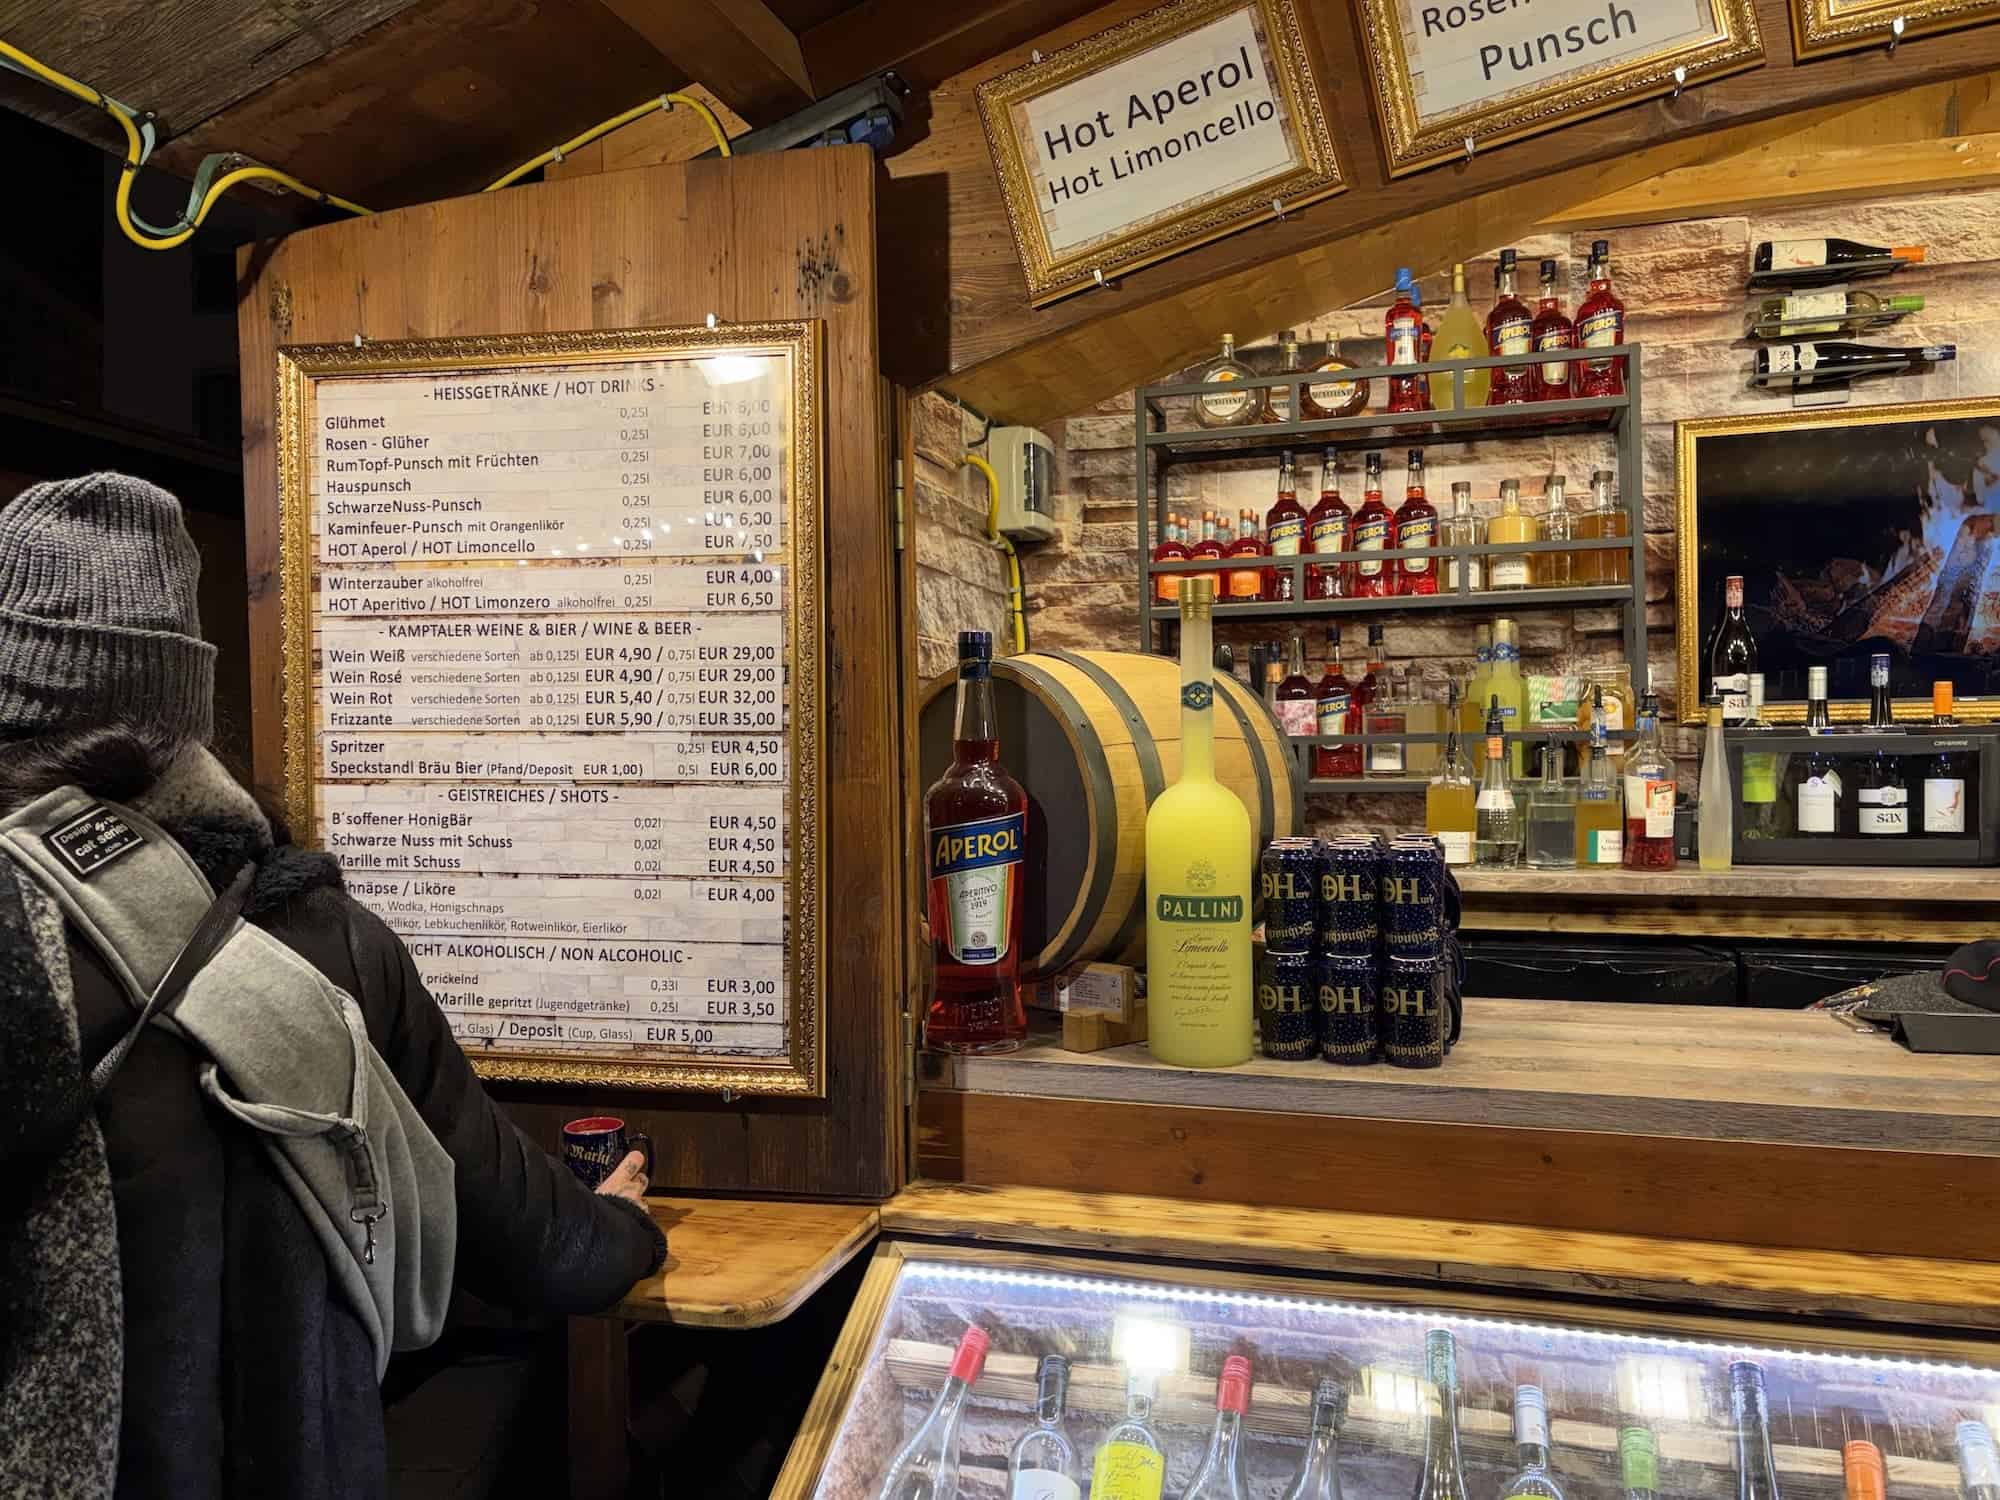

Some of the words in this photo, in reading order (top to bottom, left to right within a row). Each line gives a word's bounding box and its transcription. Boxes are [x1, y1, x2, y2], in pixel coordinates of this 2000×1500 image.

[1480, 2, 1636, 80] Punsch
[1045, 111, 1114, 161] Hot
[1128, 46, 1253, 129] Aperol
[1049, 167, 1103, 204] Hot
[1110, 100, 1274, 180] Limoncello
[434, 382, 548, 401] HEISSGETRÄNKE
[565, 381, 596, 396] HOT
[325, 416, 385, 429] Glühmet
[326, 438, 367, 450] Rosen
[382, 436, 429, 449] Glüher
[704, 424, 732, 437] EUR
[327, 456, 443, 474] RumTopf-Punsch
[448, 455, 470, 469] mit
[476, 454, 539, 467] Früchten
[621, 452, 649, 463] 0,25l
[704, 446, 733, 459] EUR
[739, 444, 770, 460] 7,00
[327, 478, 411, 494] Hauspunsch
[621, 474, 649, 485] 0,25l
[704, 468, 733, 481] EUR
[739, 467, 771, 482] 6,00
[327, 498, 482, 514] SchwarzeNuss-Punsch
[622, 495, 650, 506] 0,25l
[704, 490, 734, 504] EUR
[739, 489, 772, 505] 6,00
[328, 520, 462, 536] Kaminfeuer-Punsch
[468, 521, 486, 532] mit
[490, 520, 564, 535] Orangenlikör
[1270, 526, 1302, 541] APEROL
[1313, 522, 1345, 539] APEROL
[1401, 523, 1432, 539] APEROL
[328, 544, 357, 556] HOT
[362, 542, 406, 557] Aperol
[423, 541, 452, 553] HOT
[457, 540, 535, 553] Limoncello
[623, 539, 651, 550] 0,25l
[705, 535, 734, 548] EUR
[329, 577, 423, 590] Winterzauber
[427, 577, 483, 588] alkoholfrei
[624, 575, 652, 586] 0,25l
[707, 571, 735, 584] EUR
[740, 570, 773, 585] 4,00
[329, 599, 358, 611] HOT
[362, 597, 426, 612] Aperitivo
[441, 597, 470, 609] HOT
[475, 596, 550, 609] Limonzero
[557, 596, 615, 609] alkoholfrei
[625, 597, 652, 607] 0,25l
[707, 593, 736, 606] EUR
[741, 592, 773, 607] 6,50
[389, 625, 471, 638] KAMPTALER
[476, 624, 523, 637] WEINE
[546, 624, 577, 636] BIER
[593, 623, 633, 635] WINE
[655, 622, 692, 634] BEER
[330, 650, 365, 663] Wein
[370, 649, 405, 662] Weiß
[411, 651, 482, 663] verschiedene
[485, 651, 520, 662] Sorten
[530, 651, 544, 662] ab
[585, 648, 614, 661] EUR
[619, 648, 652, 663] 4,90
[668, 649, 695, 662] 0,75l
[698, 647, 728, 660] EUR
[733, 647, 775, 662] 29,00
[330, 671, 365, 683] Wein
[370, 671, 401, 683] Rosé
[585, 669, 614, 682] EUR
[619, 669, 652, 684] 4,90
[699, 669, 728, 681] EUR
[733, 668, 775, 684] 29,00
[330, 692, 365, 705] Wein
[370, 692, 392, 705] Rot
[585, 691, 615, 704] EUR
[620, 691, 652, 706] 5,40
[733, 691, 775, 706] 32,00
[331, 713, 392, 726] Frizzante
[620, 712, 652, 728] 5,90
[733, 712, 775, 727] 35,00
[331, 741, 384, 754] Spritzer
[677, 743, 704, 755] 0,25l
[712, 741, 741, 753] EUR
[746, 741, 778, 756] 4,50
[331, 761, 414, 776] Speckstandl
[419, 762, 450, 774] Bräu
[456, 762, 482, 774] Bier
[486, 763, 573, 776] (Pfand/Deposit
[583, 765, 612, 775] EUR
[614, 764, 643, 777] 1,00)
[678, 765, 698, 776] 0,5l
[711, 763, 739, 775] EUR
[745, 763, 777, 778] 6,00
[448, 789, 544, 803] GEISTREICHES
[560, 790, 608, 803] SHOTS
[409, 813, 472, 828] HonigBär
[710, 817, 739, 829] EUR
[744, 817, 776, 832] 4,50
[1876, 812, 1902, 823] sax
[60, 823, 92, 843] Design
[76, 840, 97, 856] cat
[332, 833, 396, 847] Schwarze
[401, 835, 434, 847] Nuss
[440, 835, 464, 848] mit
[468, 835, 513, 848] Schuss
[709, 838, 738, 850] EUR
[743, 839, 774, 853] 4,50
[936, 829, 1018, 866] APEROL
[386, 855, 408, 868] mit
[414, 855, 460, 868] Schuss
[709, 860, 738, 872] EUR
[743, 860, 774, 875] 4,50
[414, 881, 455, 896] Liköre
[708, 888, 738, 901] EUR
[743, 888, 774, 904] 4,00
[388, 902, 427, 914] Wodka,
[430, 903, 504, 917] Honigschnaps
[1163, 900, 1237, 918] PALLINI
[448, 945, 544, 959] ALKOHOLISCH
[561, 948, 593, 961] NON
[599, 949, 683, 963] ALCOHOLIC
[427, 974, 478, 985] prickelnd
[651, 980, 678, 991] 0,33l
[708, 980, 737, 993] EUR
[742, 981, 775, 996] 3,00
[435, 993, 484, 1006] Marille
[489, 999, 532, 1008] gepritzt
[651, 1002, 678, 1013] 0,25l
[707, 1002, 737, 1014] EUR
[742, 1002, 774, 1017] 3,50
[468, 1024, 494, 1033] Glas)
[510, 1023, 563, 1038] Deposit
[600, 1030, 632, 1040] Glass)
[648, 1028, 675, 1040] EUR
[681, 1029, 713, 1043] 5,00
